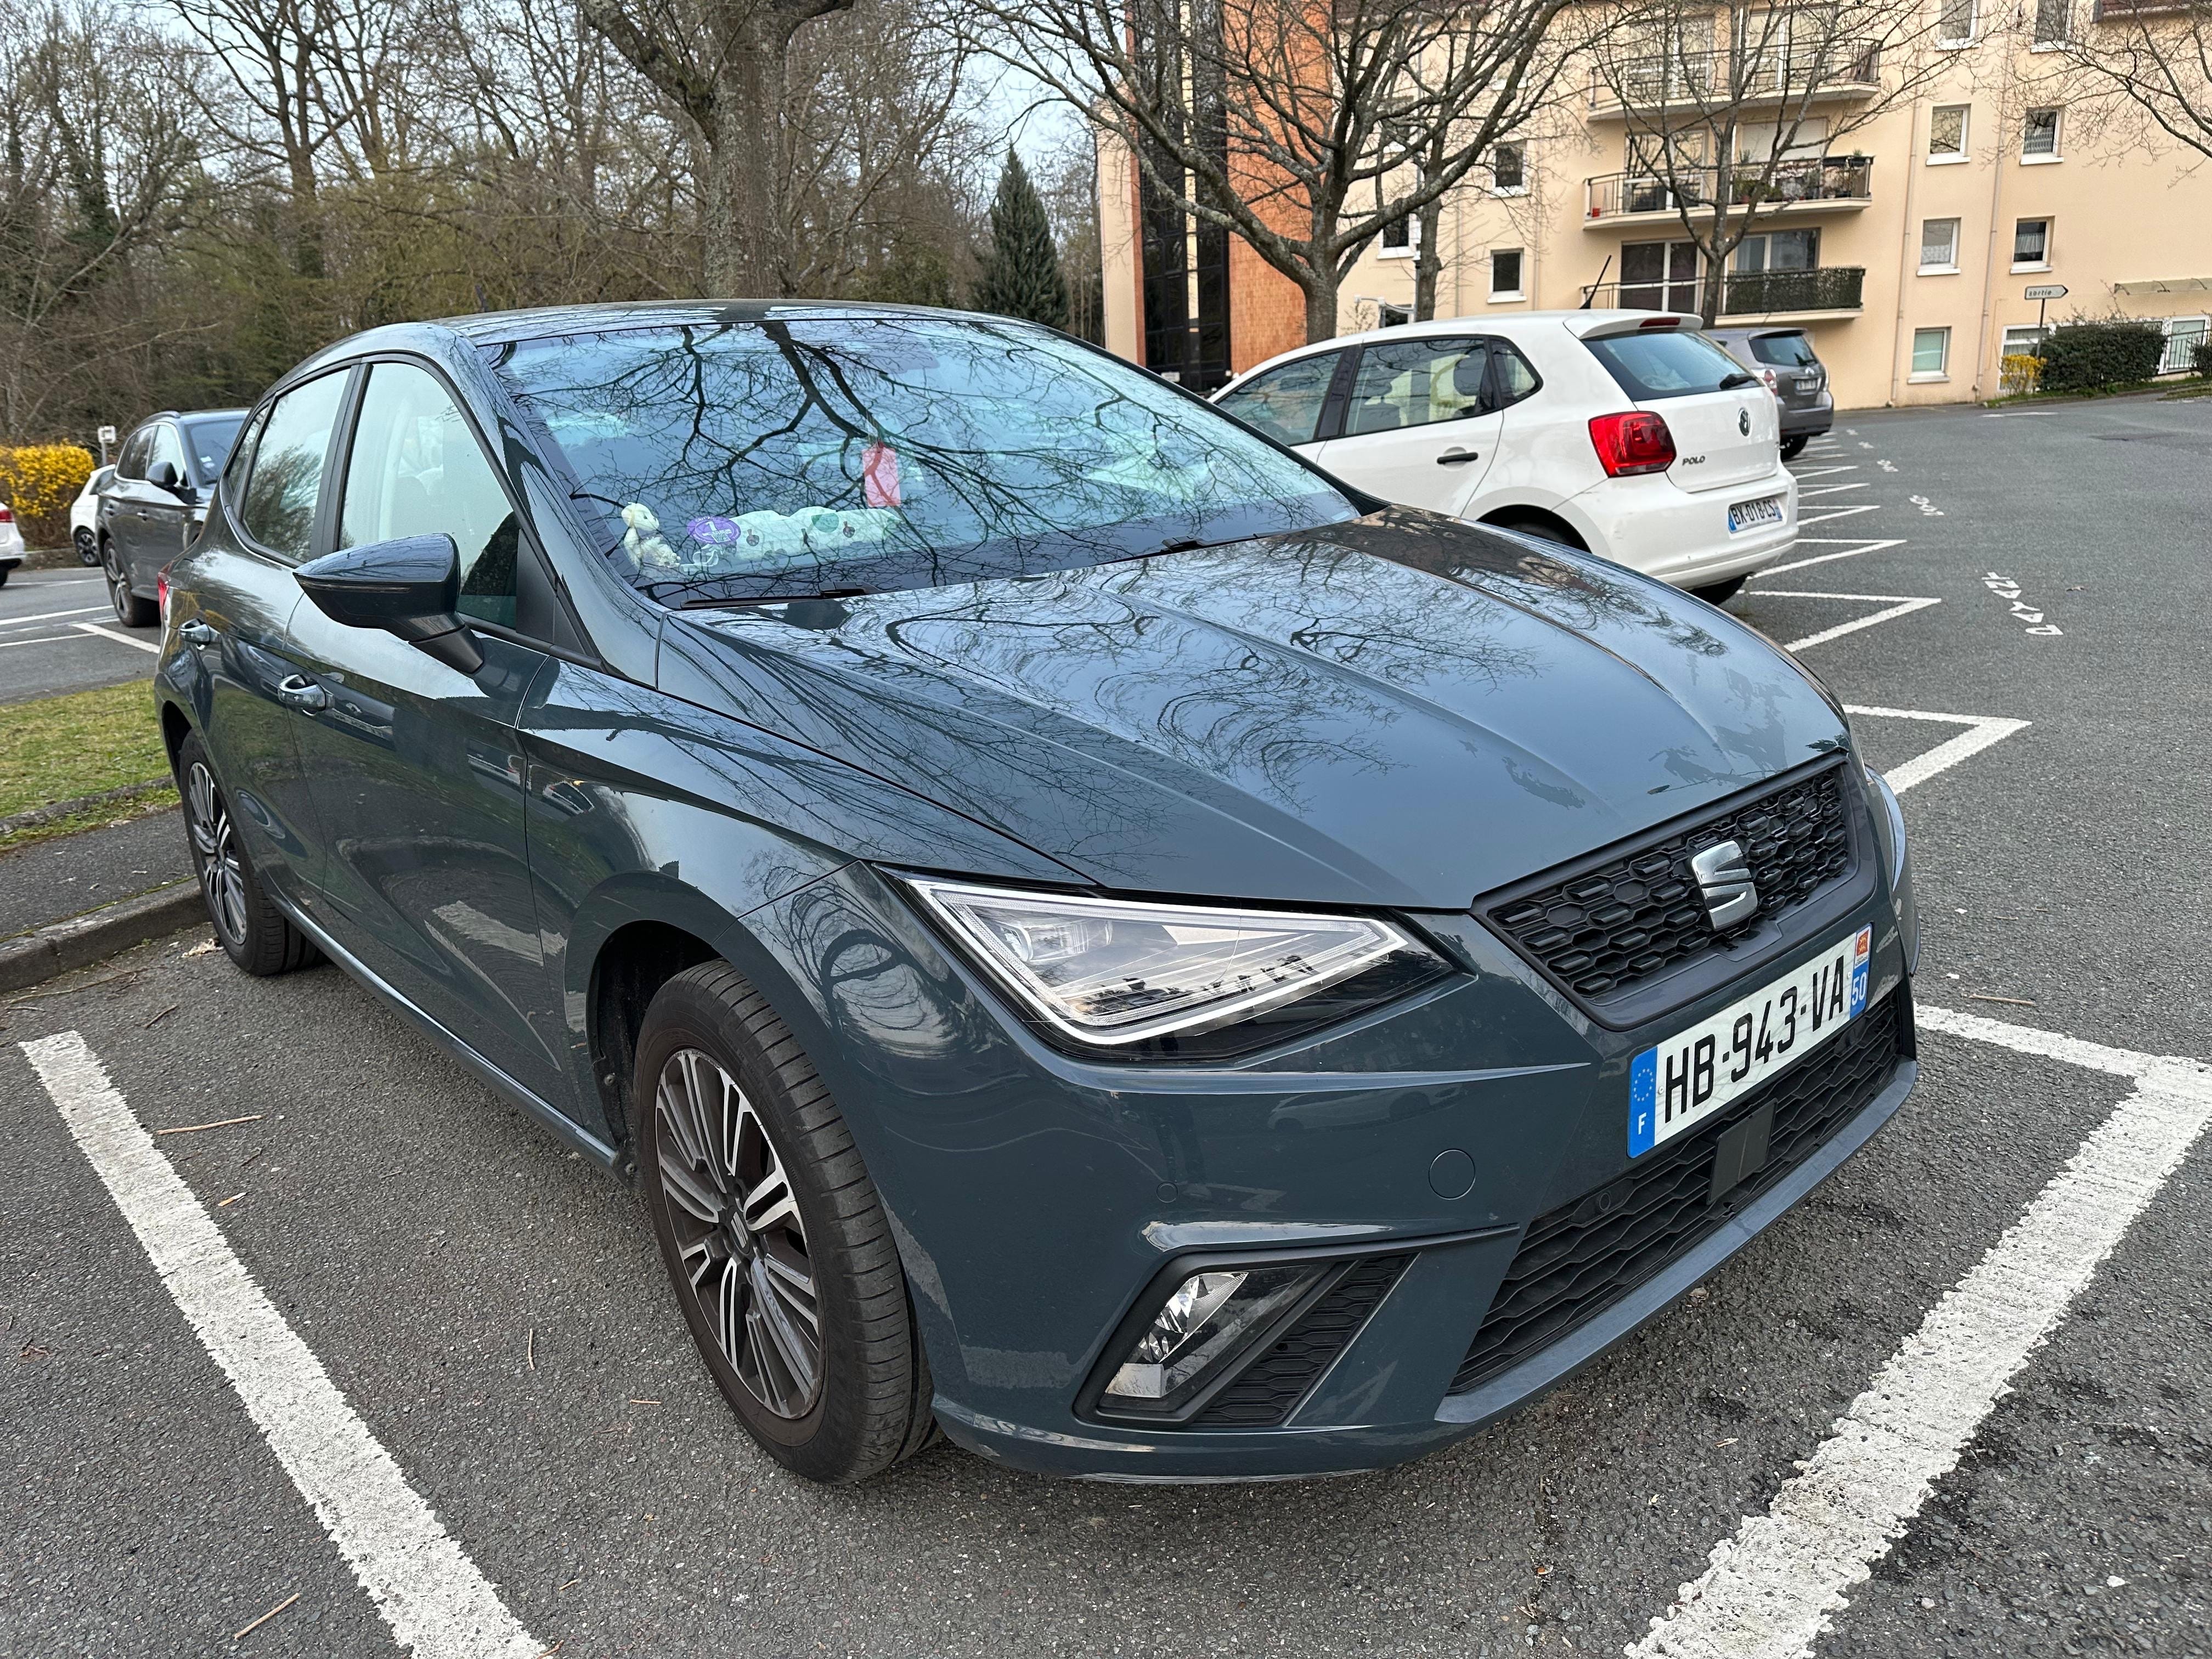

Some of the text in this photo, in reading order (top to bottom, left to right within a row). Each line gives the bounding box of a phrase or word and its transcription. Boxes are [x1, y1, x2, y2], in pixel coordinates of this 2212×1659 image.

[1682, 455, 1706, 466] POLO
[1730, 500, 1776, 525] BX-018-CS
[1852, 972, 1867, 1006] 50
[1665, 955, 1844, 1124] HB-943-VA
[1638, 1113, 1646, 1135] F
